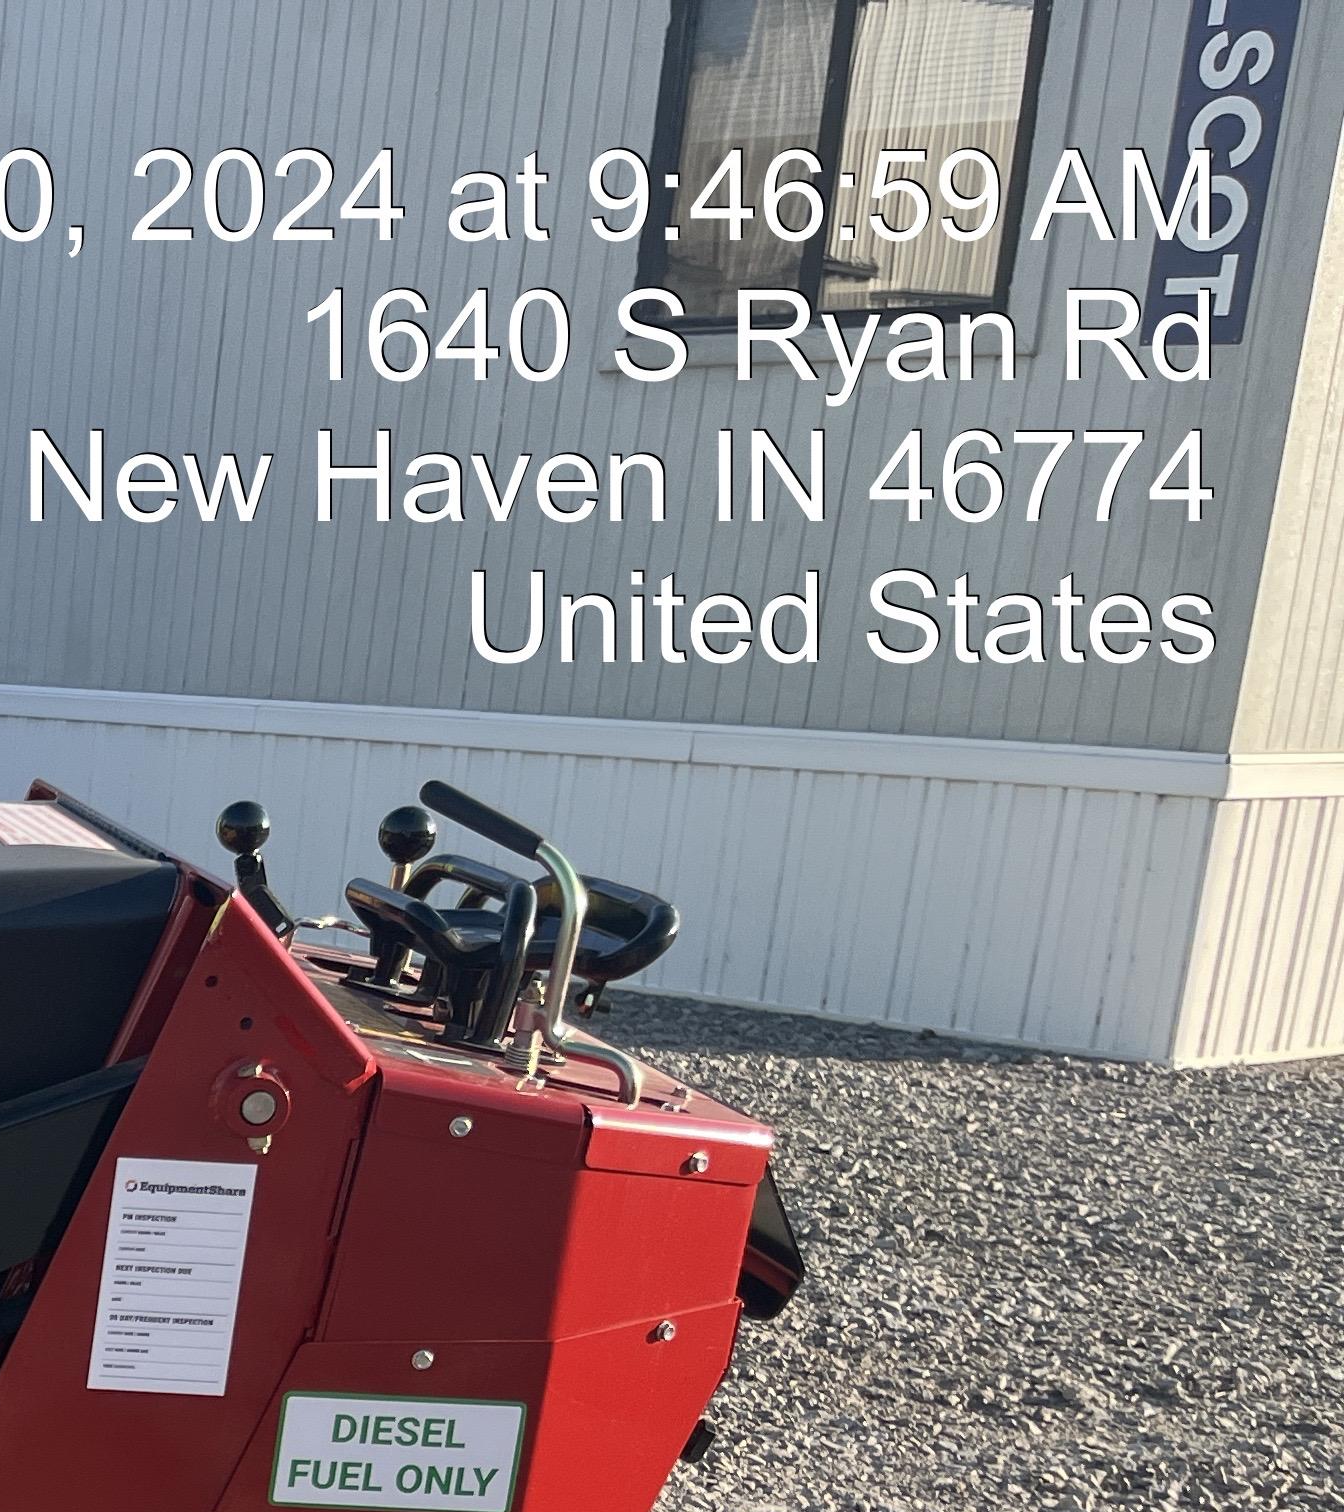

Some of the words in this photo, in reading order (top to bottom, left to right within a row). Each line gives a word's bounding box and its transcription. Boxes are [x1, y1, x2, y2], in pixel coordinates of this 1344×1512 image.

[139, 1181, 247, 1197] EquipmentShare
[134, 1214, 178, 1223] INSPECTION
[134, 1265, 176, 1274] INSPECTION
[172, 1317, 214, 1326] INSPECTION
[330, 1413, 466, 1449] DIESEL
[287, 1459, 382, 1492] FUEL
[395, 1464, 500, 1497] ONLY
